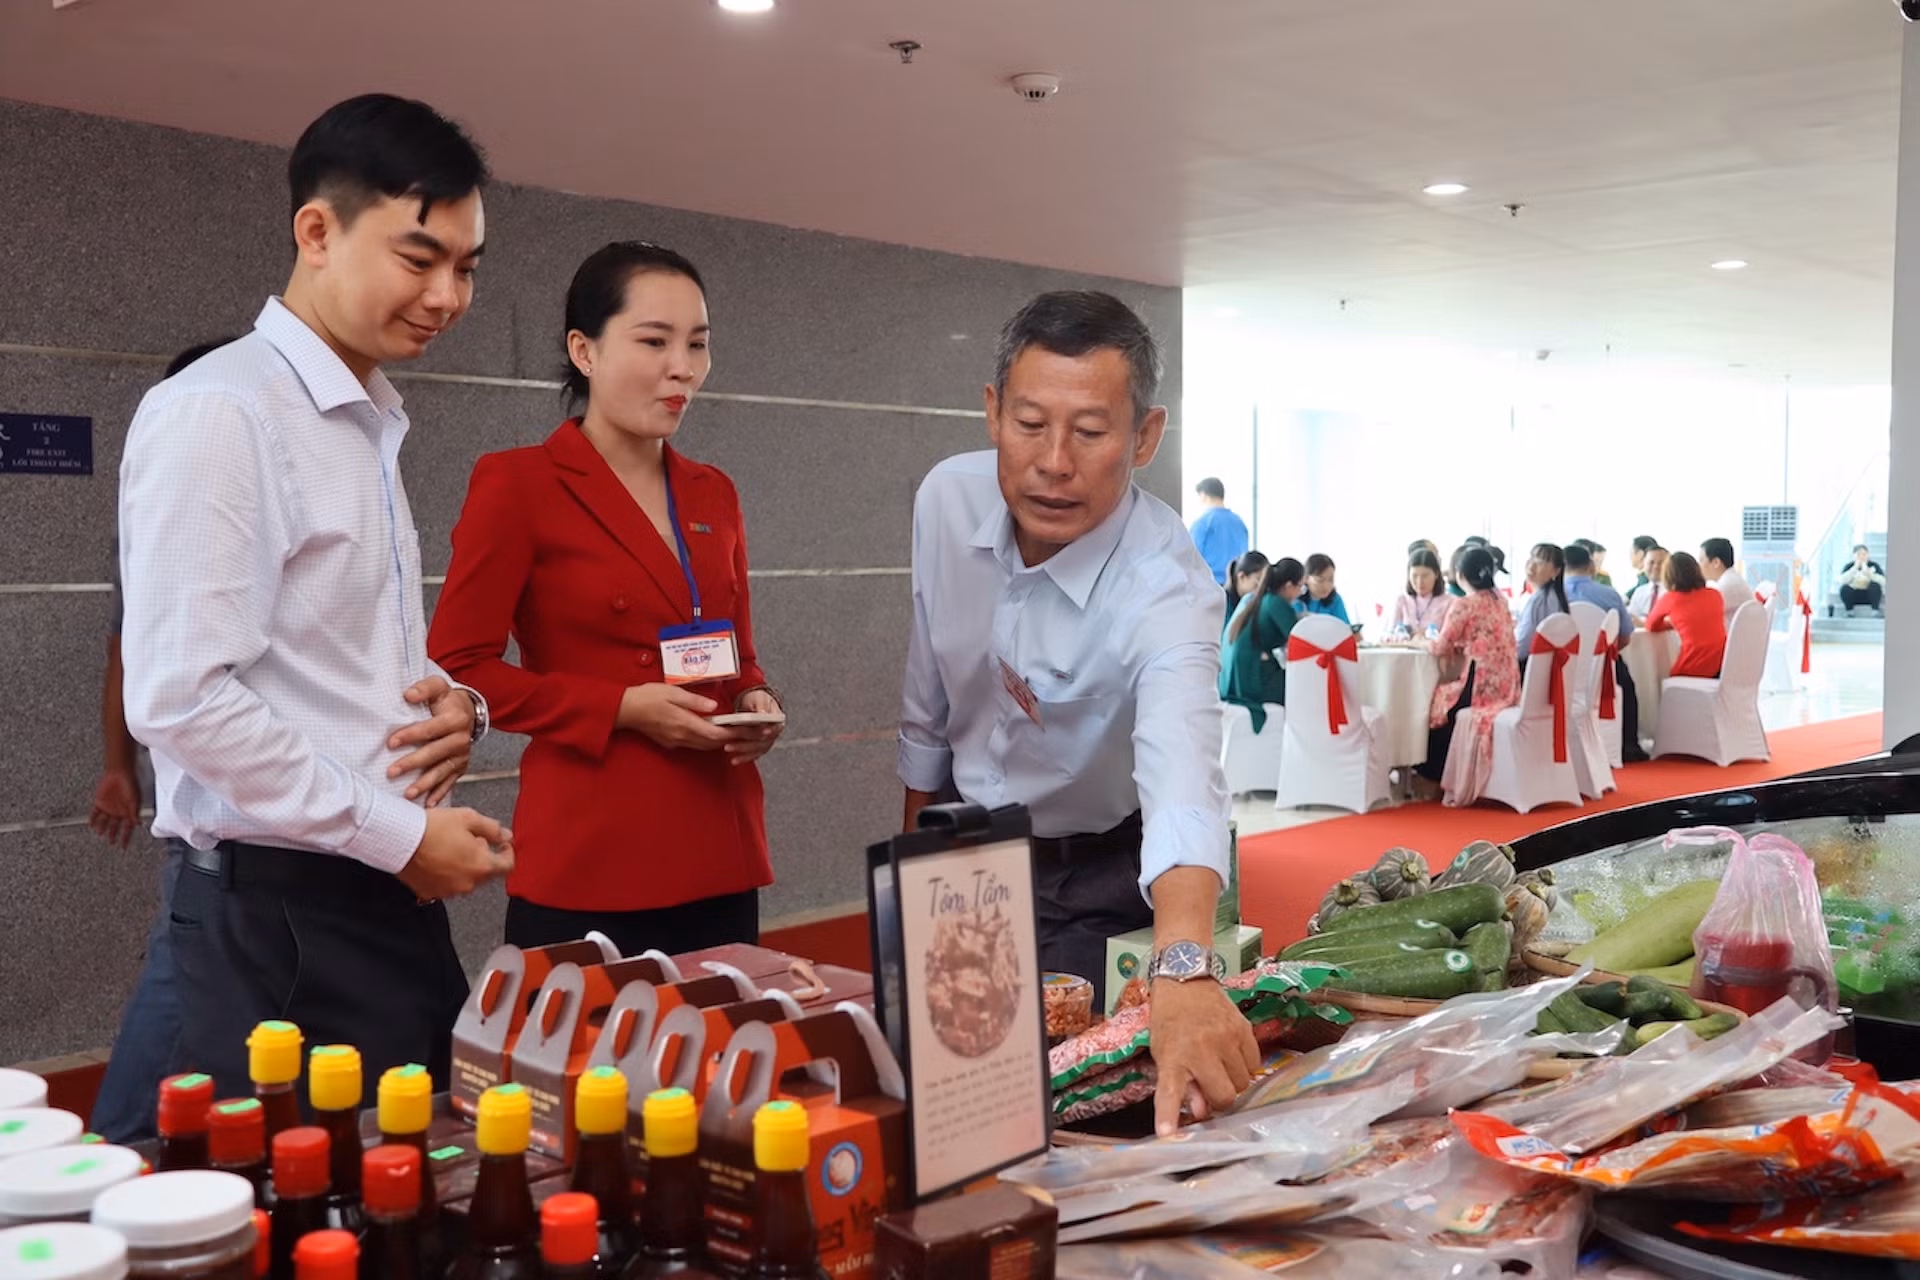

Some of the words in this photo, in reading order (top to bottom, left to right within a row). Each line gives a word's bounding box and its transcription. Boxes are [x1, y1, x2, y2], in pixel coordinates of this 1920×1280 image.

[26, 448, 45, 456] FIRE
[47, 449, 67, 457] EXIT
[928, 876, 967, 918] Tôm
